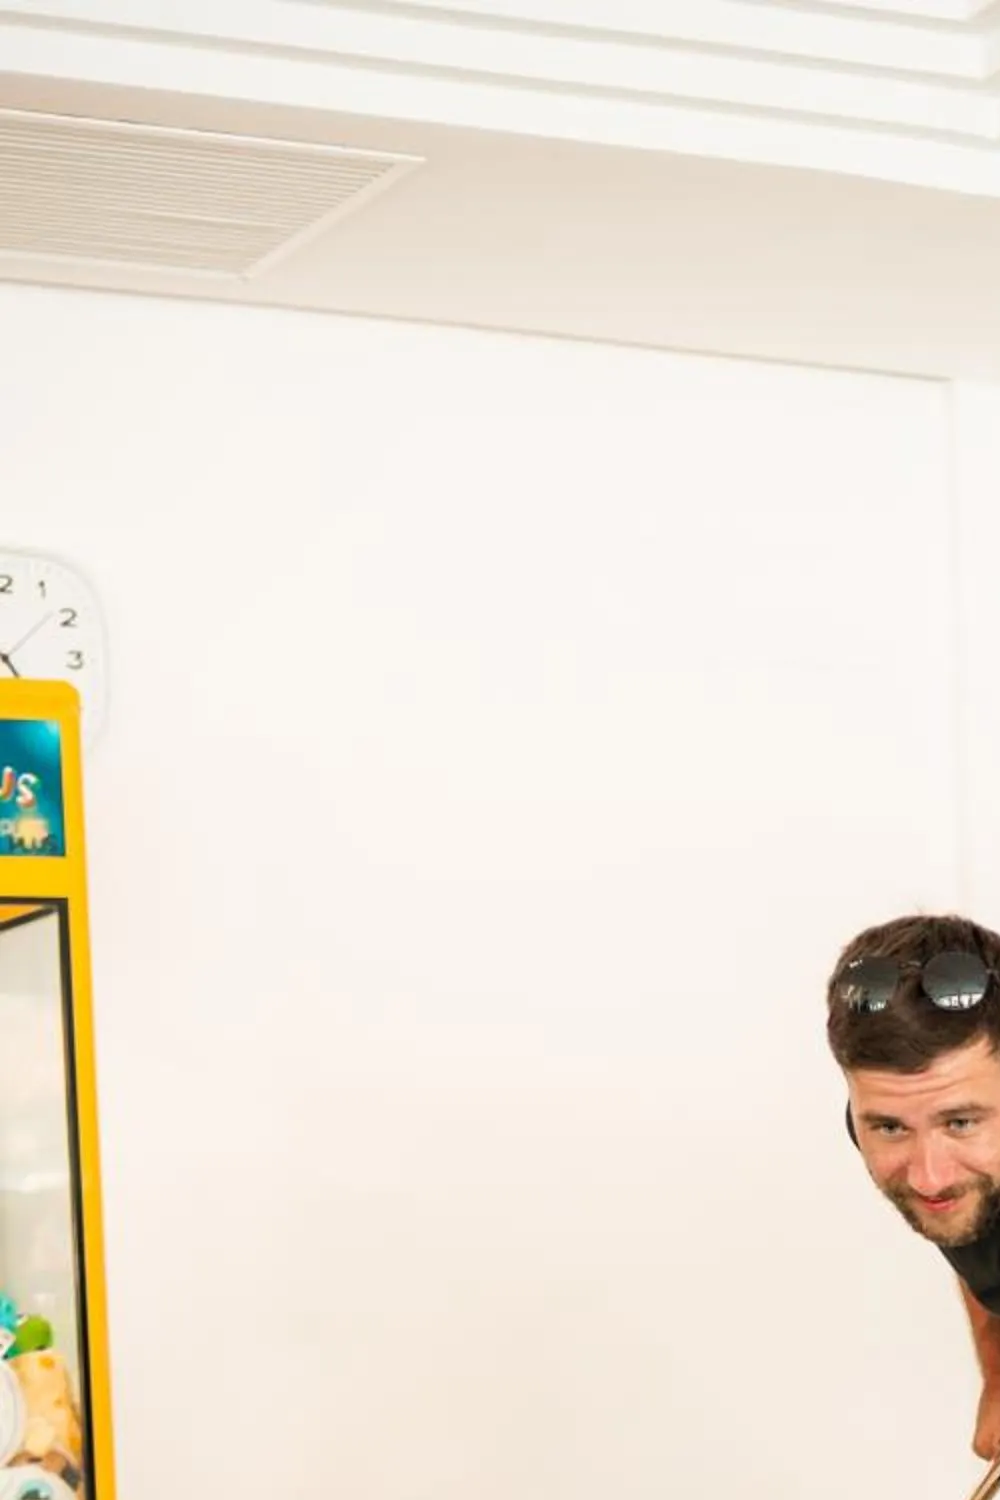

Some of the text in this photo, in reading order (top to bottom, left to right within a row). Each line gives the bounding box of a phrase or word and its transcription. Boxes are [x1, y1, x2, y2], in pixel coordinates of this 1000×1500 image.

[38, 580, 46, 600] 1
[59, 607, 78, 627] 2
[65, 650, 84, 670] 3
